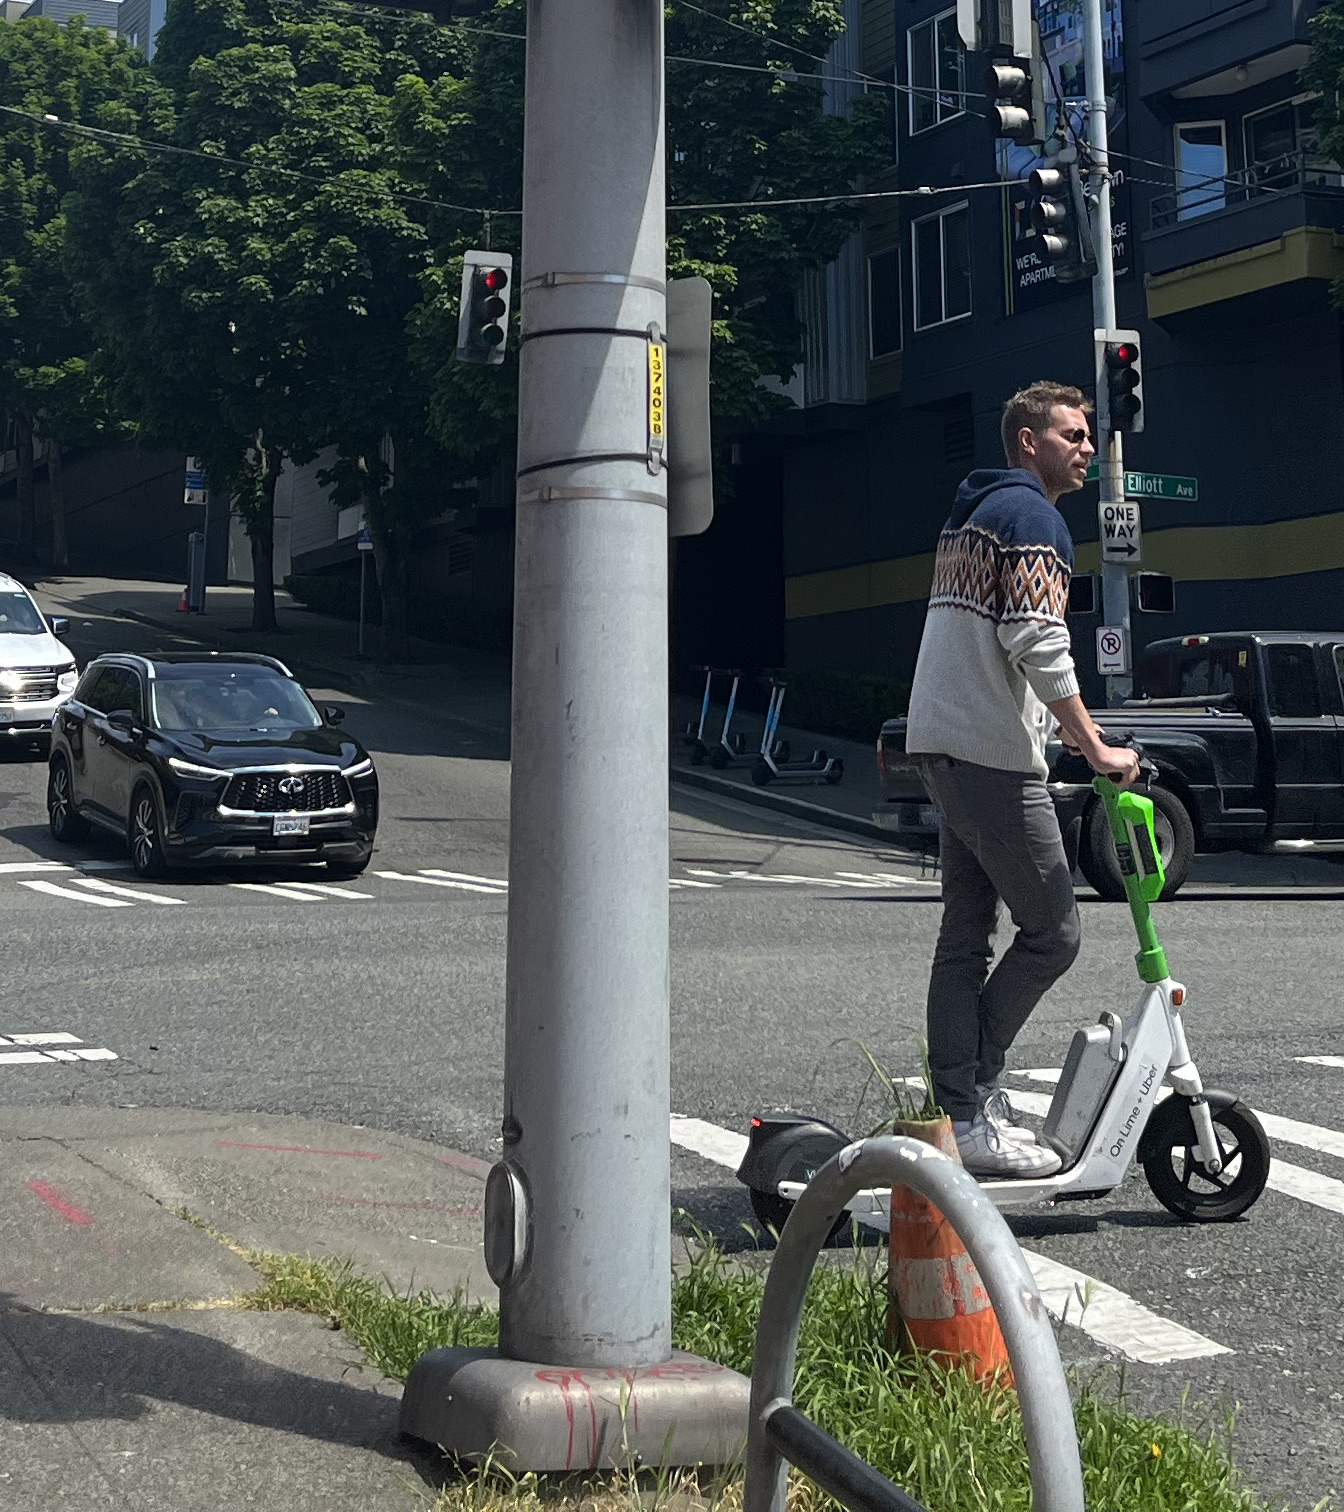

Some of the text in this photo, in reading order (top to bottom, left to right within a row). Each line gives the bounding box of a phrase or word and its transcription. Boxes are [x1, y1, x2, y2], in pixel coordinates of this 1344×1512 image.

[1127, 474, 1194, 497] Elliott Ave
[1103, 506, 1135, 521] ONE
[1103, 523, 1136, 539] WAY
[1109, 1137, 1126, 1157] On
[1119, 1106, 1141, 1138] Lime
[1138, 1063, 1159, 1096] Uber
